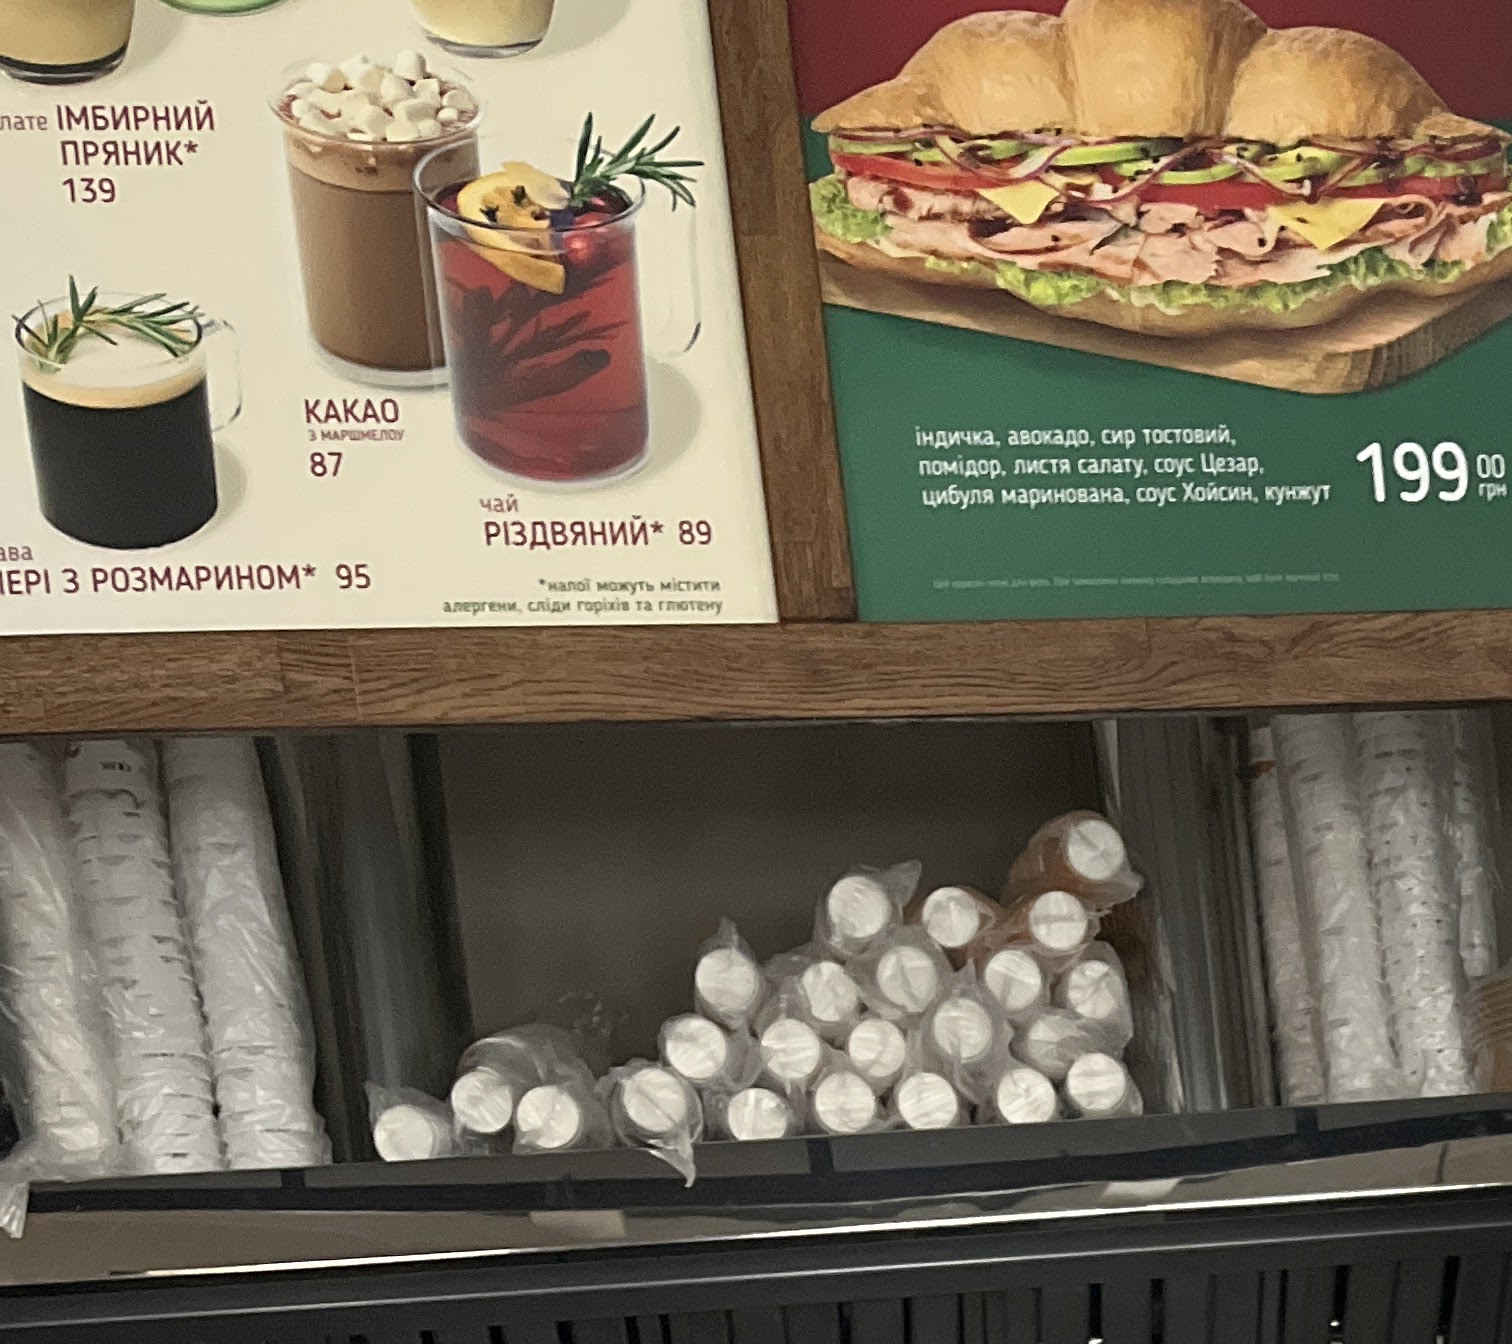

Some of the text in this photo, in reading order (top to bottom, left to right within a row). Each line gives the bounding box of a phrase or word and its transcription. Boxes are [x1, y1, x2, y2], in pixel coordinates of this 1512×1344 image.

[57, 100, 214, 131] ІМБИРНИЙ
[63, 178, 115, 203] 139
[305, 399, 398, 423] КАКАО
[915, 424, 1236, 449] індичка, авокадо, сир тостовий,
[310, 452, 342, 477] 87
[919, 453, 1264, 479] помідор, листя салату, соус Цезар,
[1357, 442, 1507, 502] 199 00 грн
[479, 494, 518, 512] чай
[922, 482, 1330, 509] цибуля маринована, соус Хойсин, кунжут
[679, 520, 712, 545] 89
[62, 568, 79, 593] З
[336, 564, 370, 589] 95
